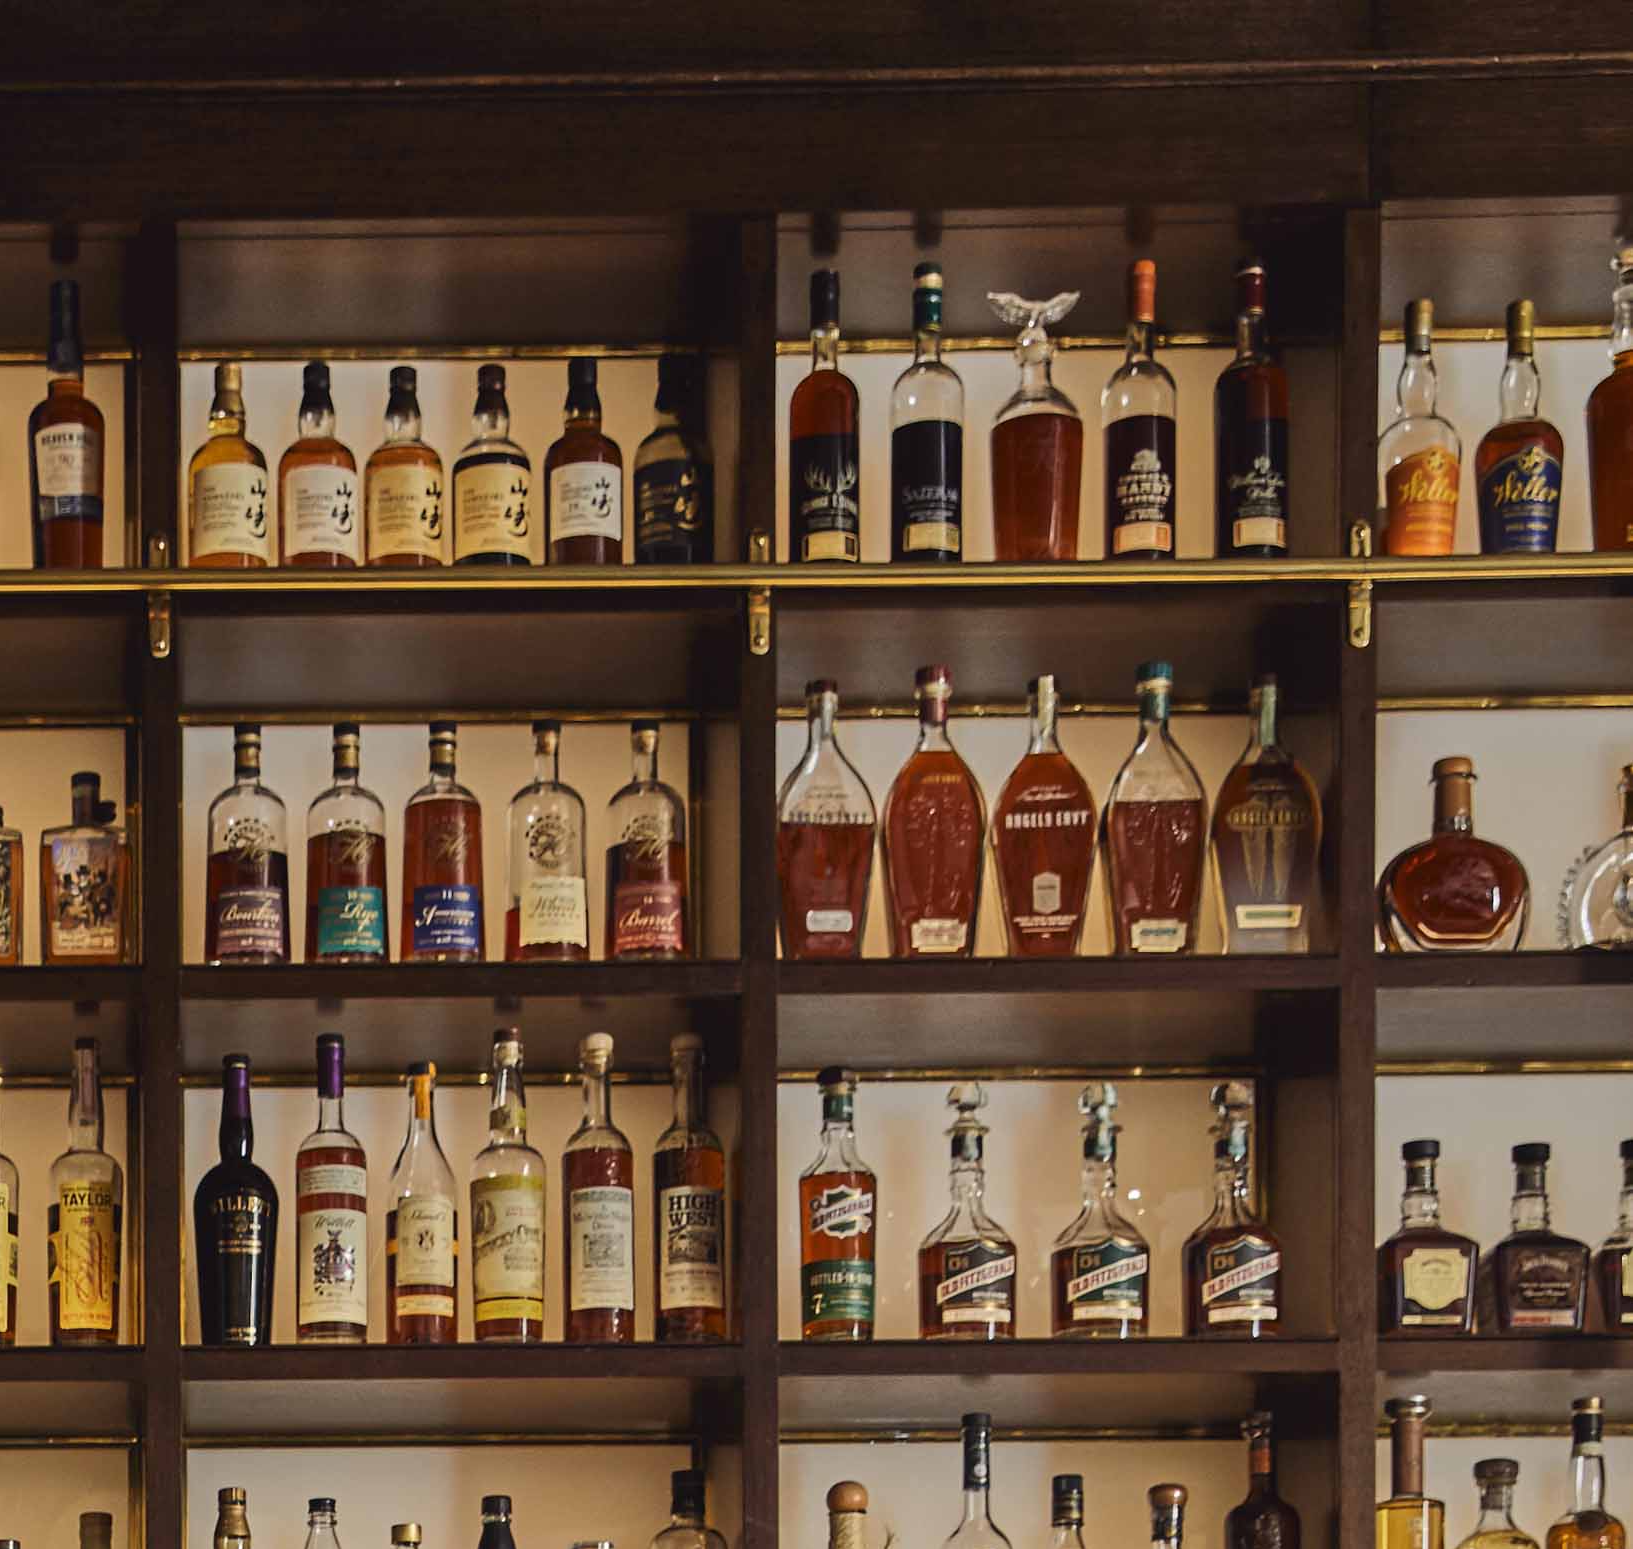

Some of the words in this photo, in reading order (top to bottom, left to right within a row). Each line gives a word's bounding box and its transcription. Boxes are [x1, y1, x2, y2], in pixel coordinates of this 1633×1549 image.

[340, 901, 379, 931] Rye
[62, 1193, 111, 1207] TAYLOR
[669, 1195, 716, 1212] HIGH
[669, 1212, 717, 1229] WEST
[940, 1280, 958, 1298] OLD
[958, 1259, 1014, 1291] FITZGERALD
[1070, 1278, 1087, 1295] OLD
[1087, 1256, 1145, 1288] FITZGERALD
[1207, 1279, 1224, 1297] OLD
[1224, 1255, 1280, 1288] FITZGERALD
[813, 1293, 823, 1315] 7
